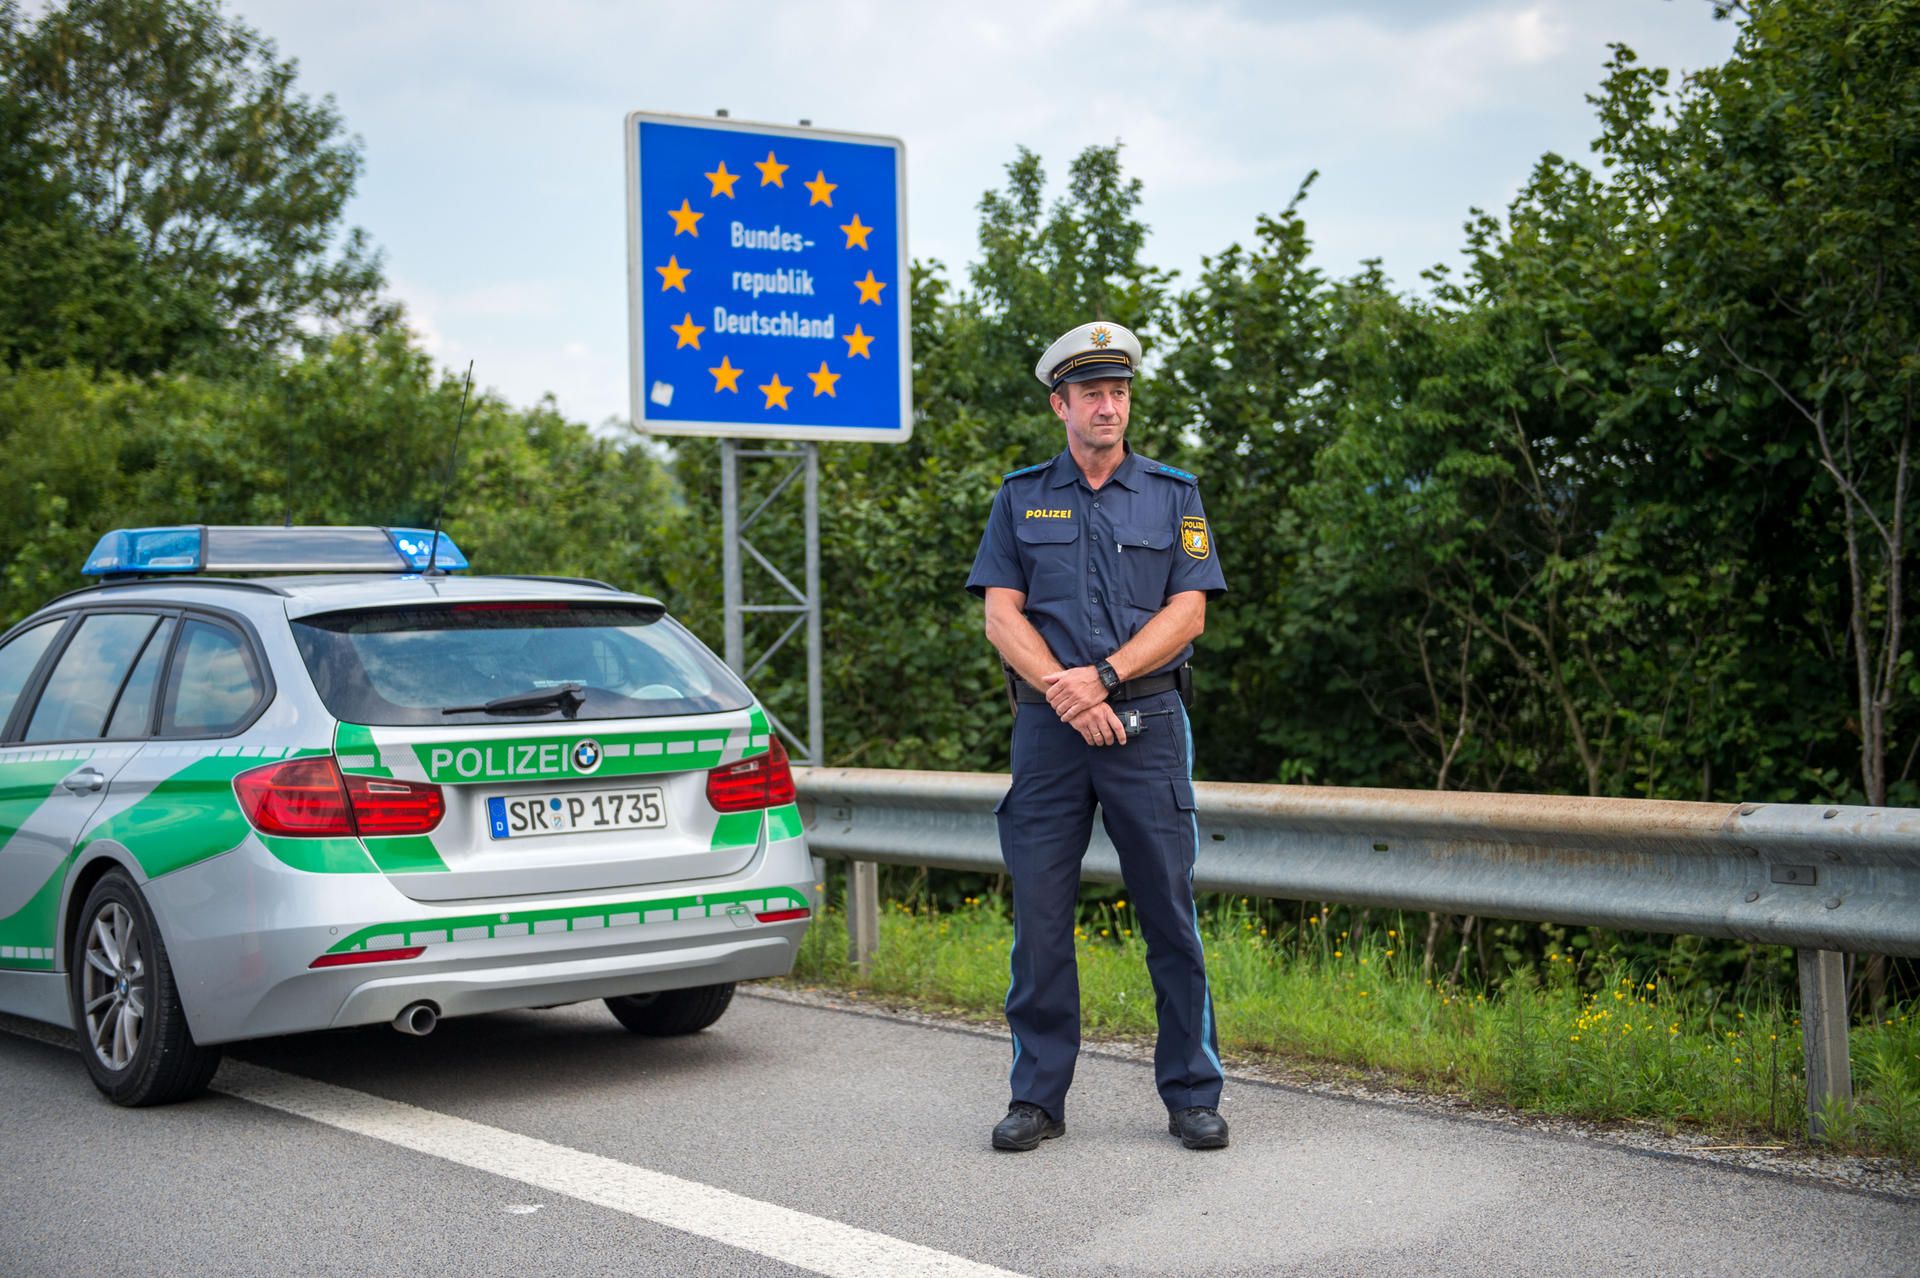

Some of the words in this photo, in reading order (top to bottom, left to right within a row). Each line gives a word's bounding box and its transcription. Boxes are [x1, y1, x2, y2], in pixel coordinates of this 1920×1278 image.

[731, 221, 815, 252] Bundes-
[732, 268, 814, 298] republik
[714, 306, 834, 339] Deutschland
[1025, 508, 1072, 519] POLIZEI
[431, 743, 568, 778] POLIZEI
[496, 821, 504, 831] D
[510, 800, 549, 831] SR
[566, 798, 585, 828] P
[592, 793, 660, 826] 1735
